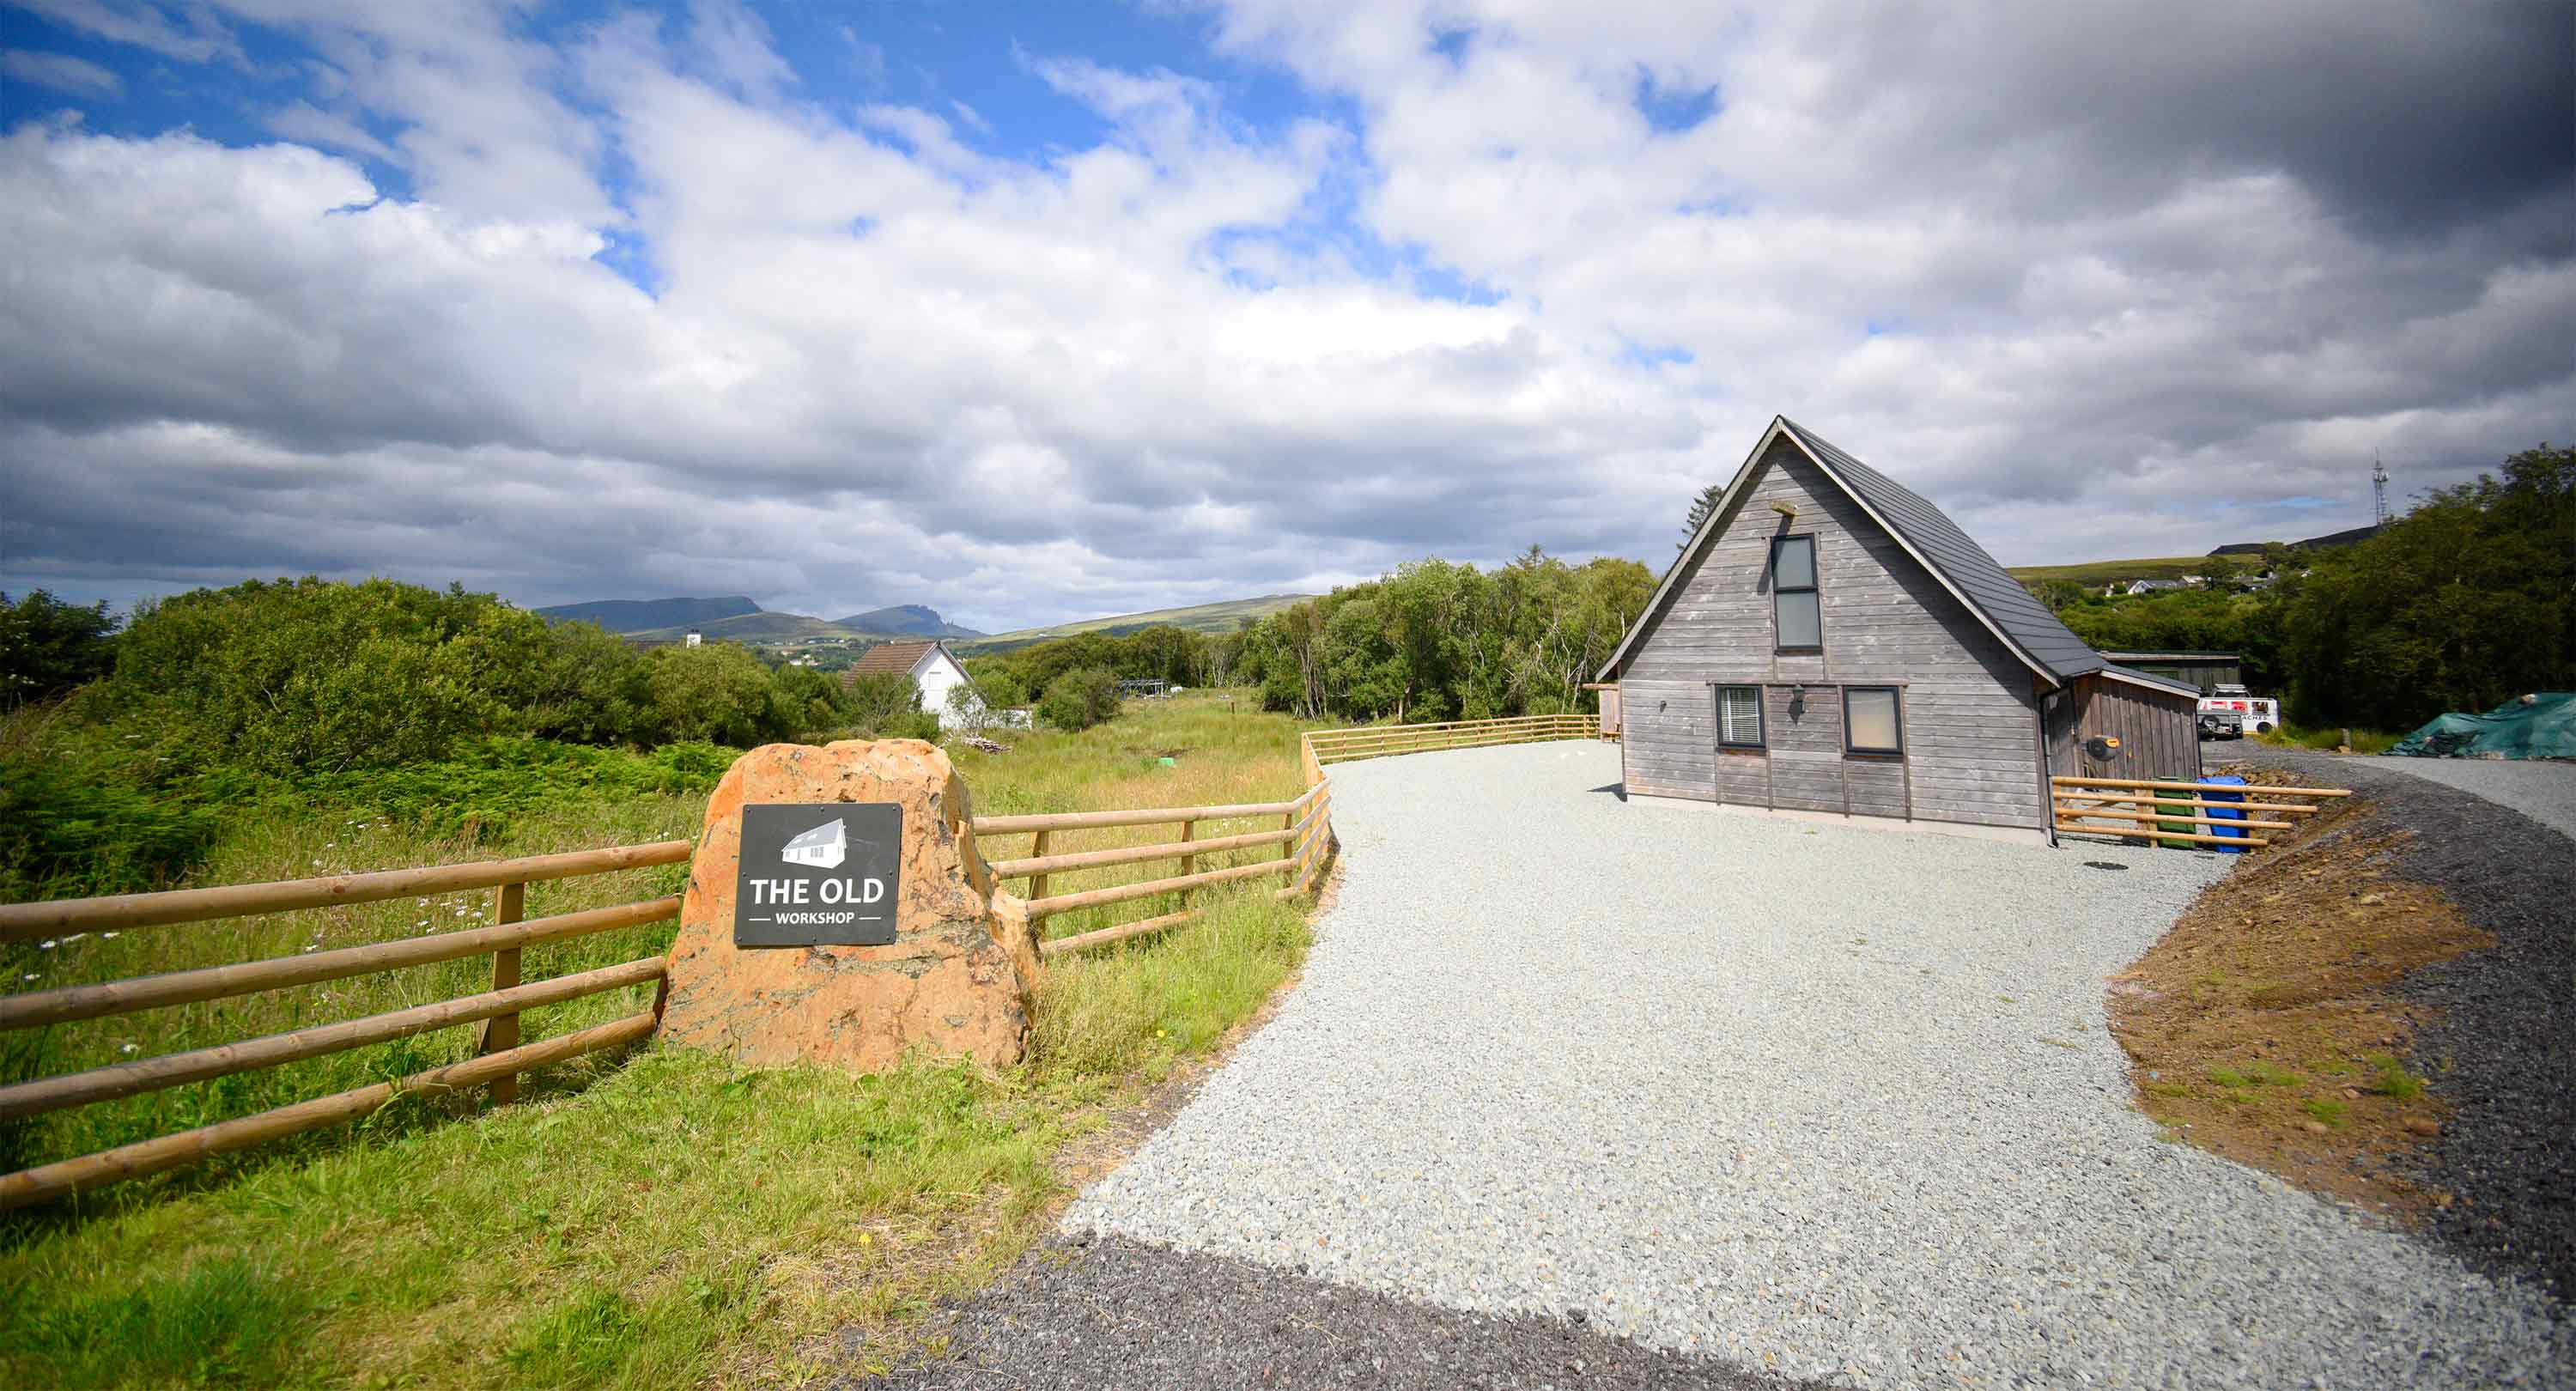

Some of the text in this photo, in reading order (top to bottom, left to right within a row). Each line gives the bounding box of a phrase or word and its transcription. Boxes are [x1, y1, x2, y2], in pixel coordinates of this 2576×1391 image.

[750, 878, 884, 904] THE OLD
[775, 912, 855, 925] WORKSHOP
